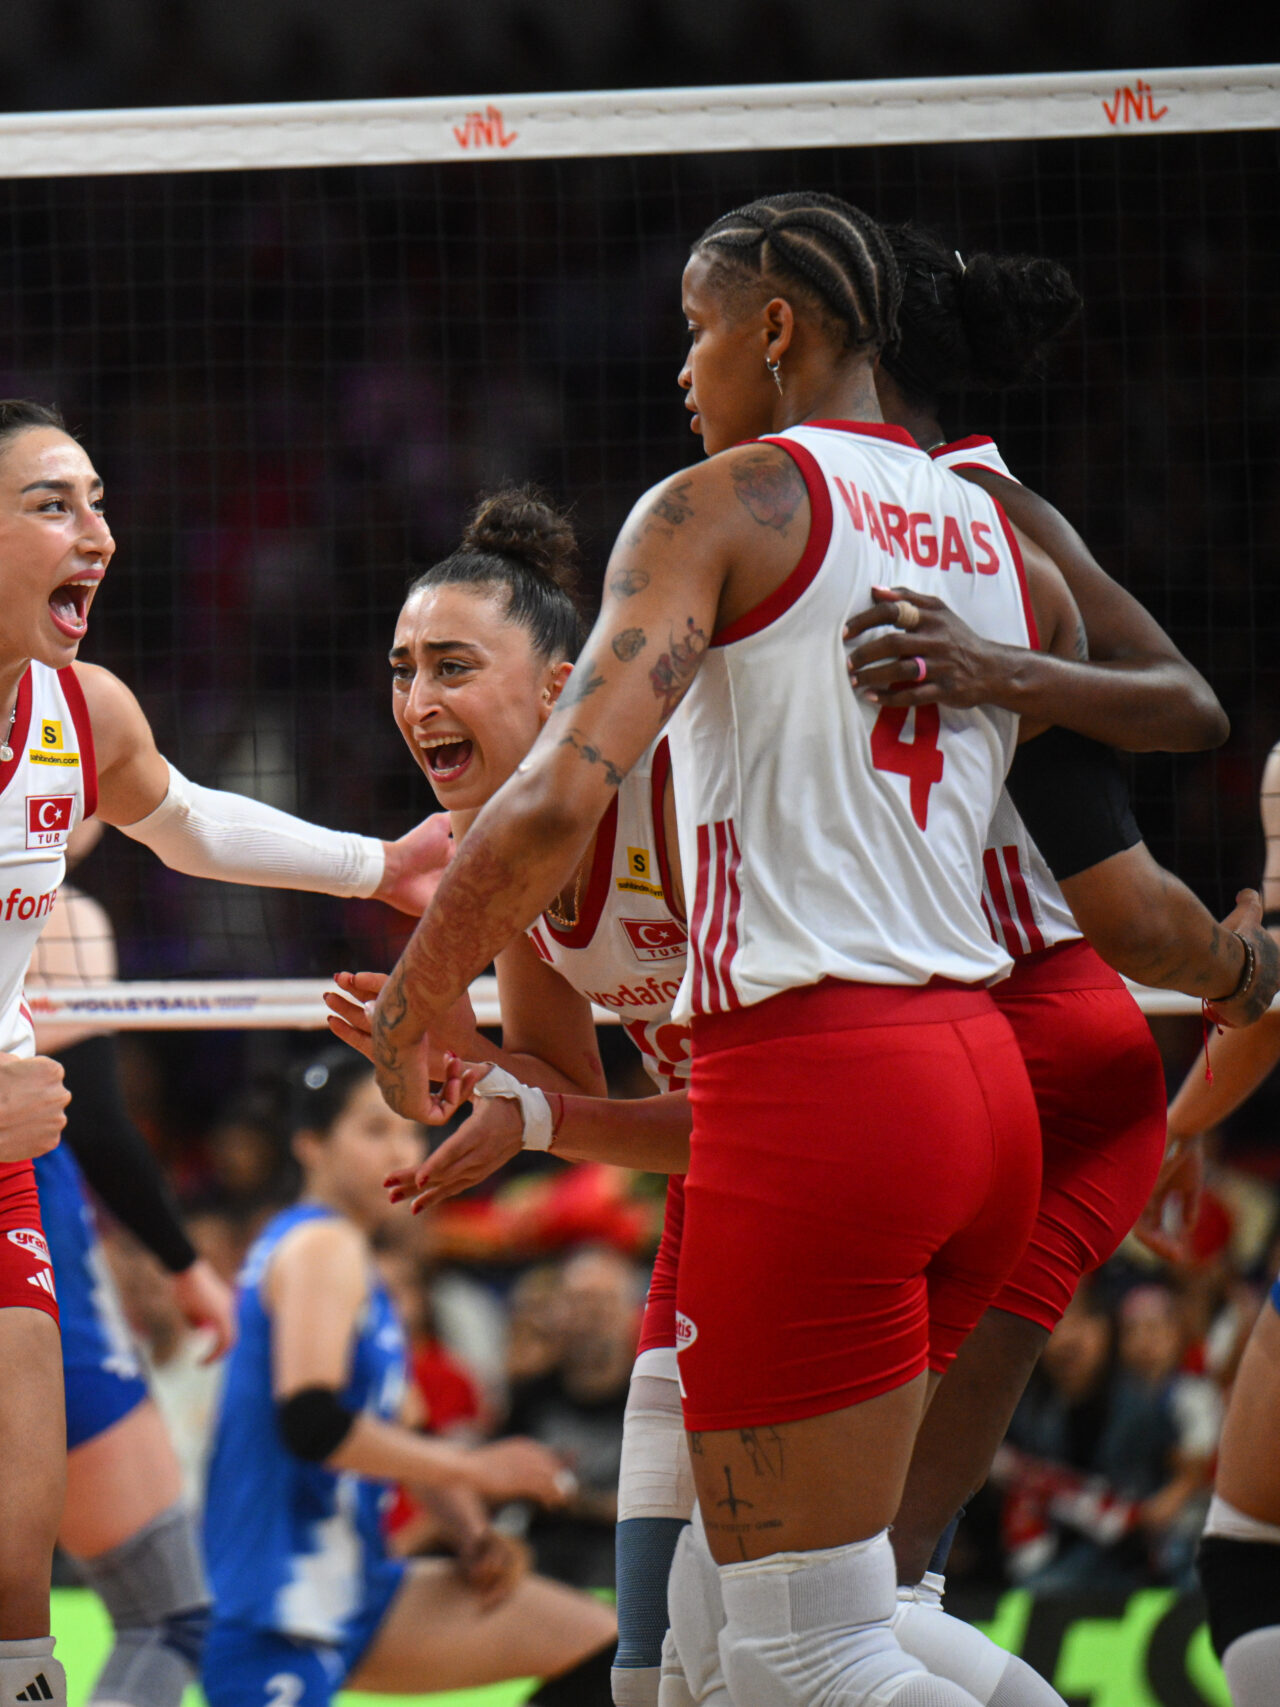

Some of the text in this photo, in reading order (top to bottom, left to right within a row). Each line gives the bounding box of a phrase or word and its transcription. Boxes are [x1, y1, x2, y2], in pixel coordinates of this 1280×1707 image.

[1101, 78, 1169, 125] VNL
[452, 104, 518, 149] VNL
[833, 476, 1000, 576] VARGAS
[44, 726, 57, 744] S
[869, 681, 945, 832] 4
[37, 833, 61, 845] TUR
[633, 854, 647, 873] S
[647, 945, 684, 959] TUR
[584, 977, 683, 1007] vodafo
